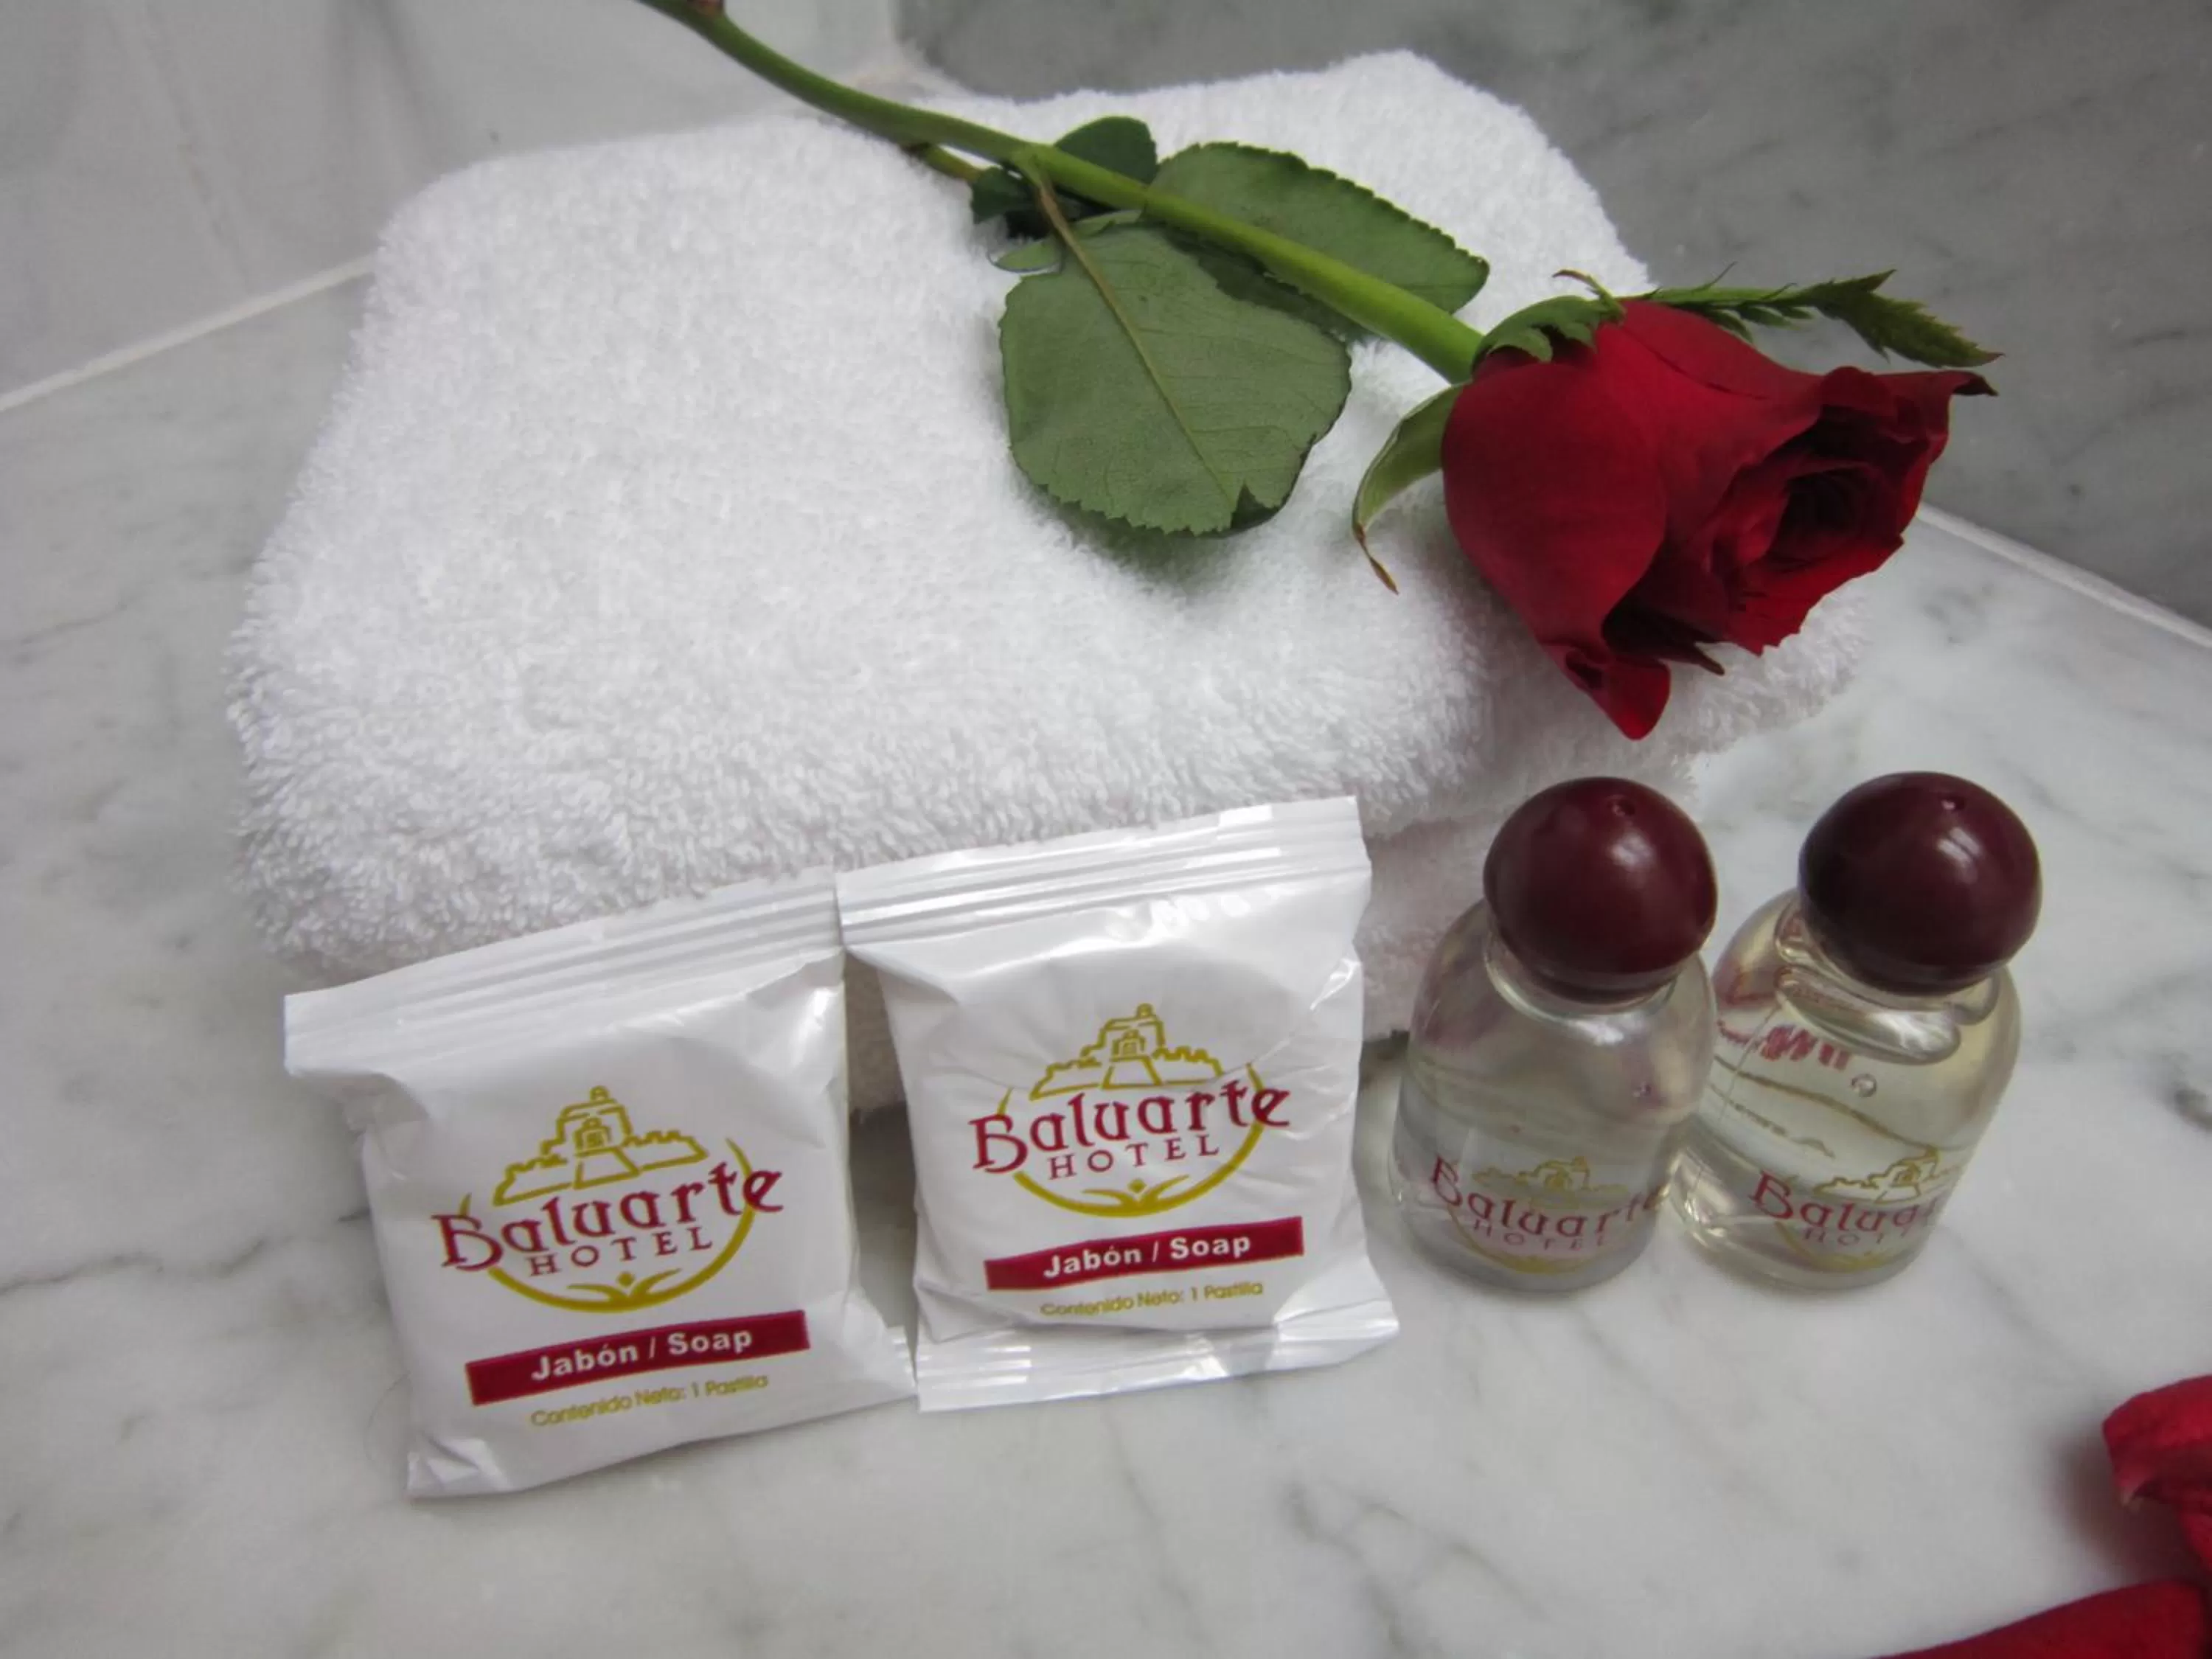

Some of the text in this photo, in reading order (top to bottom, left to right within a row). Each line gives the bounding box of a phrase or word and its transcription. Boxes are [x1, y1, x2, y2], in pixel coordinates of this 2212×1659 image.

[968, 1079, 1290, 1174] Baluarte
[1048, 1134, 1219, 1180] HOTEL
[431, 1161, 785, 1271] Baluarte
[529, 1227, 713, 1277] HOTEL
[1043, 1235, 1251, 1279] Jabón / Soap
[1040, 1281, 1264, 1316] Contenido Neto: 1 Pastilla
[531, 1329, 752, 1381] Jabón / Soap
[530, 1374, 769, 1427] Contenido Neto: 1 Pastilla
